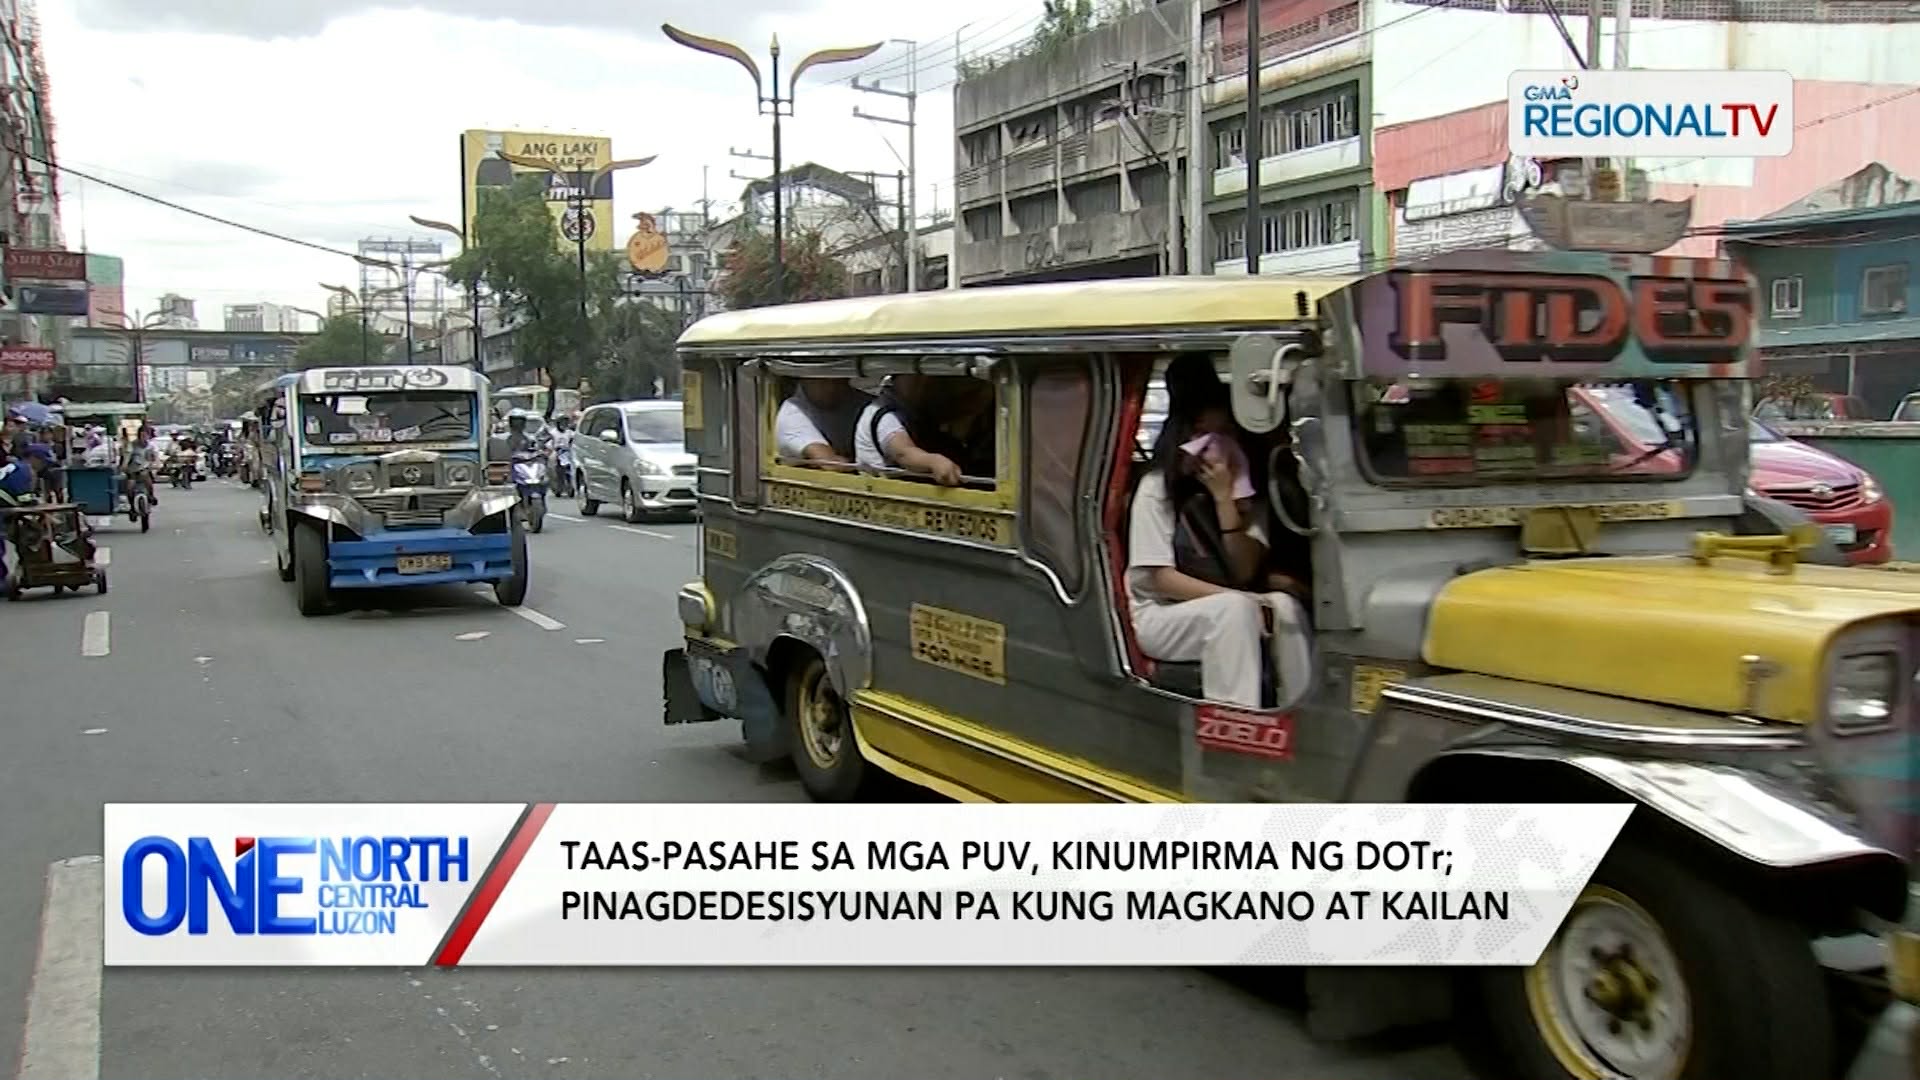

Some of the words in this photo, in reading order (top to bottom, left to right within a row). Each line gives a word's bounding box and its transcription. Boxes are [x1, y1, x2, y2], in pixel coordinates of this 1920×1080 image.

[521, 142, 557, 156] ANG
[563, 141, 597, 155] LAKI
[7, 253, 41, 266] Sun
[44, 253, 81, 268] Star
[1388, 272, 1754, 363] FIDES
[924, 510, 999, 541] REMEDIOS
[918, 641, 951, 664] FOR
[953, 651, 995, 677] HIRE
